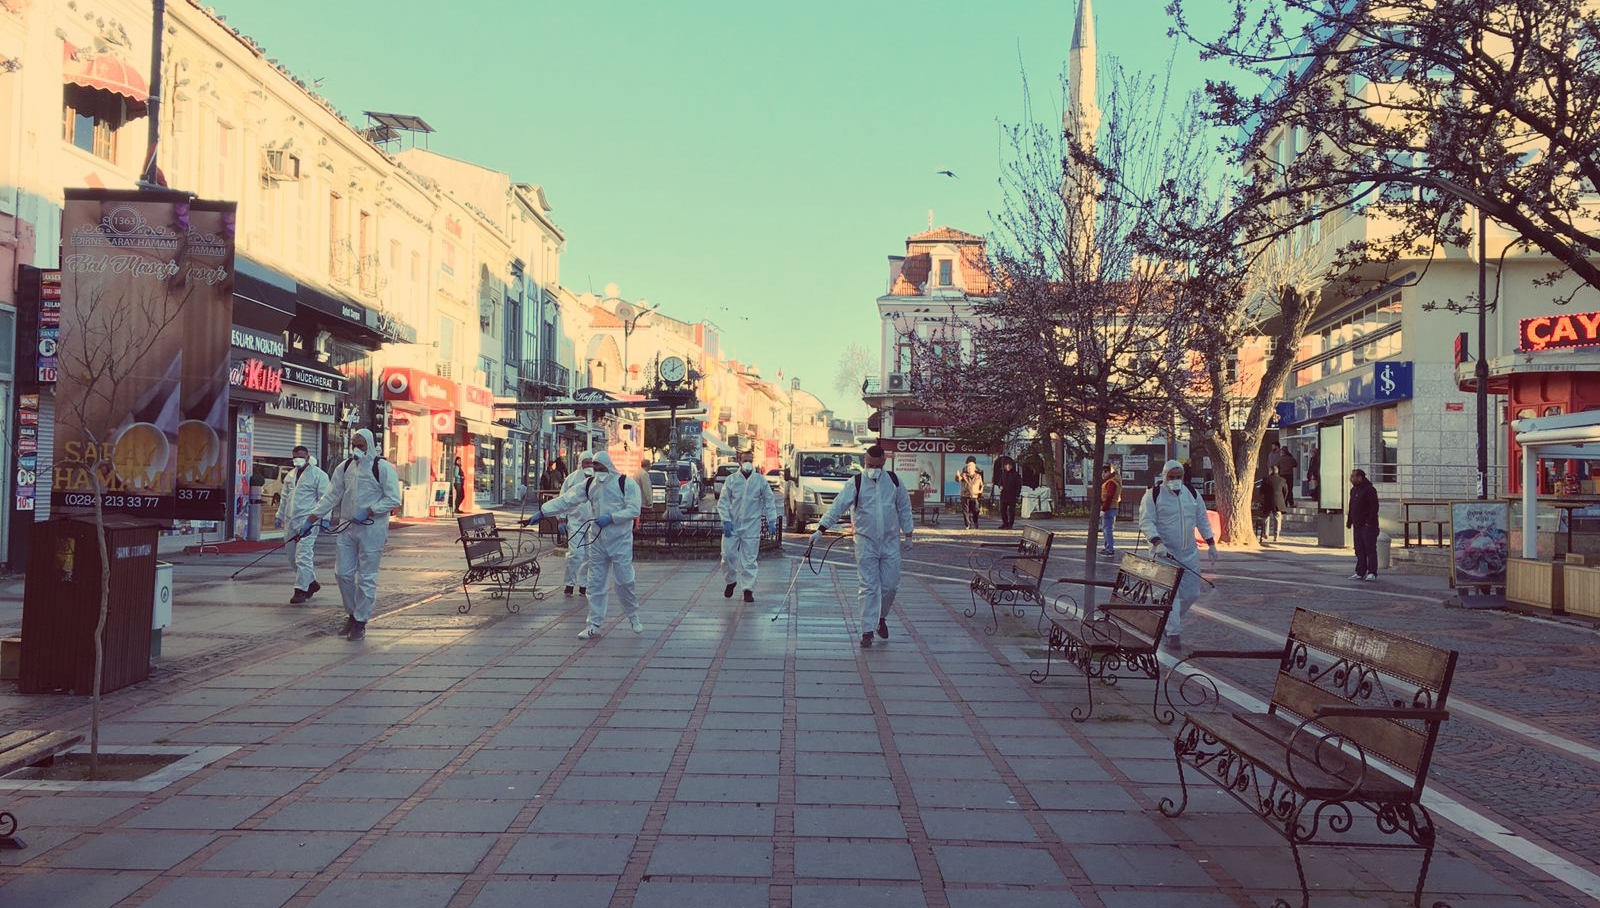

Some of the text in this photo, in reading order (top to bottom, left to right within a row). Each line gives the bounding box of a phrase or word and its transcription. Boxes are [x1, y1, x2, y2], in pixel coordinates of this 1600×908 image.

[113, 215, 136, 226] 1363
[106, 237, 135, 247] SARAY
[137, 238, 178, 248] HAMAMI
[66, 254, 108, 273] Bal
[1527, 313, 1600, 350] ÇAY
[296, 370, 333, 388] MÜCEVHERAT
[286, 393, 336, 416] MÜCEVHERAT
[684, 425, 699, 433] FLY
[896, 440, 957, 453] eczane
[237, 459, 247, 475] 10
[105, 494, 124, 507] 213
[127, 496, 141, 508] 33
[145, 497, 159, 509] 77
[178, 489, 211, 501] 33 77
